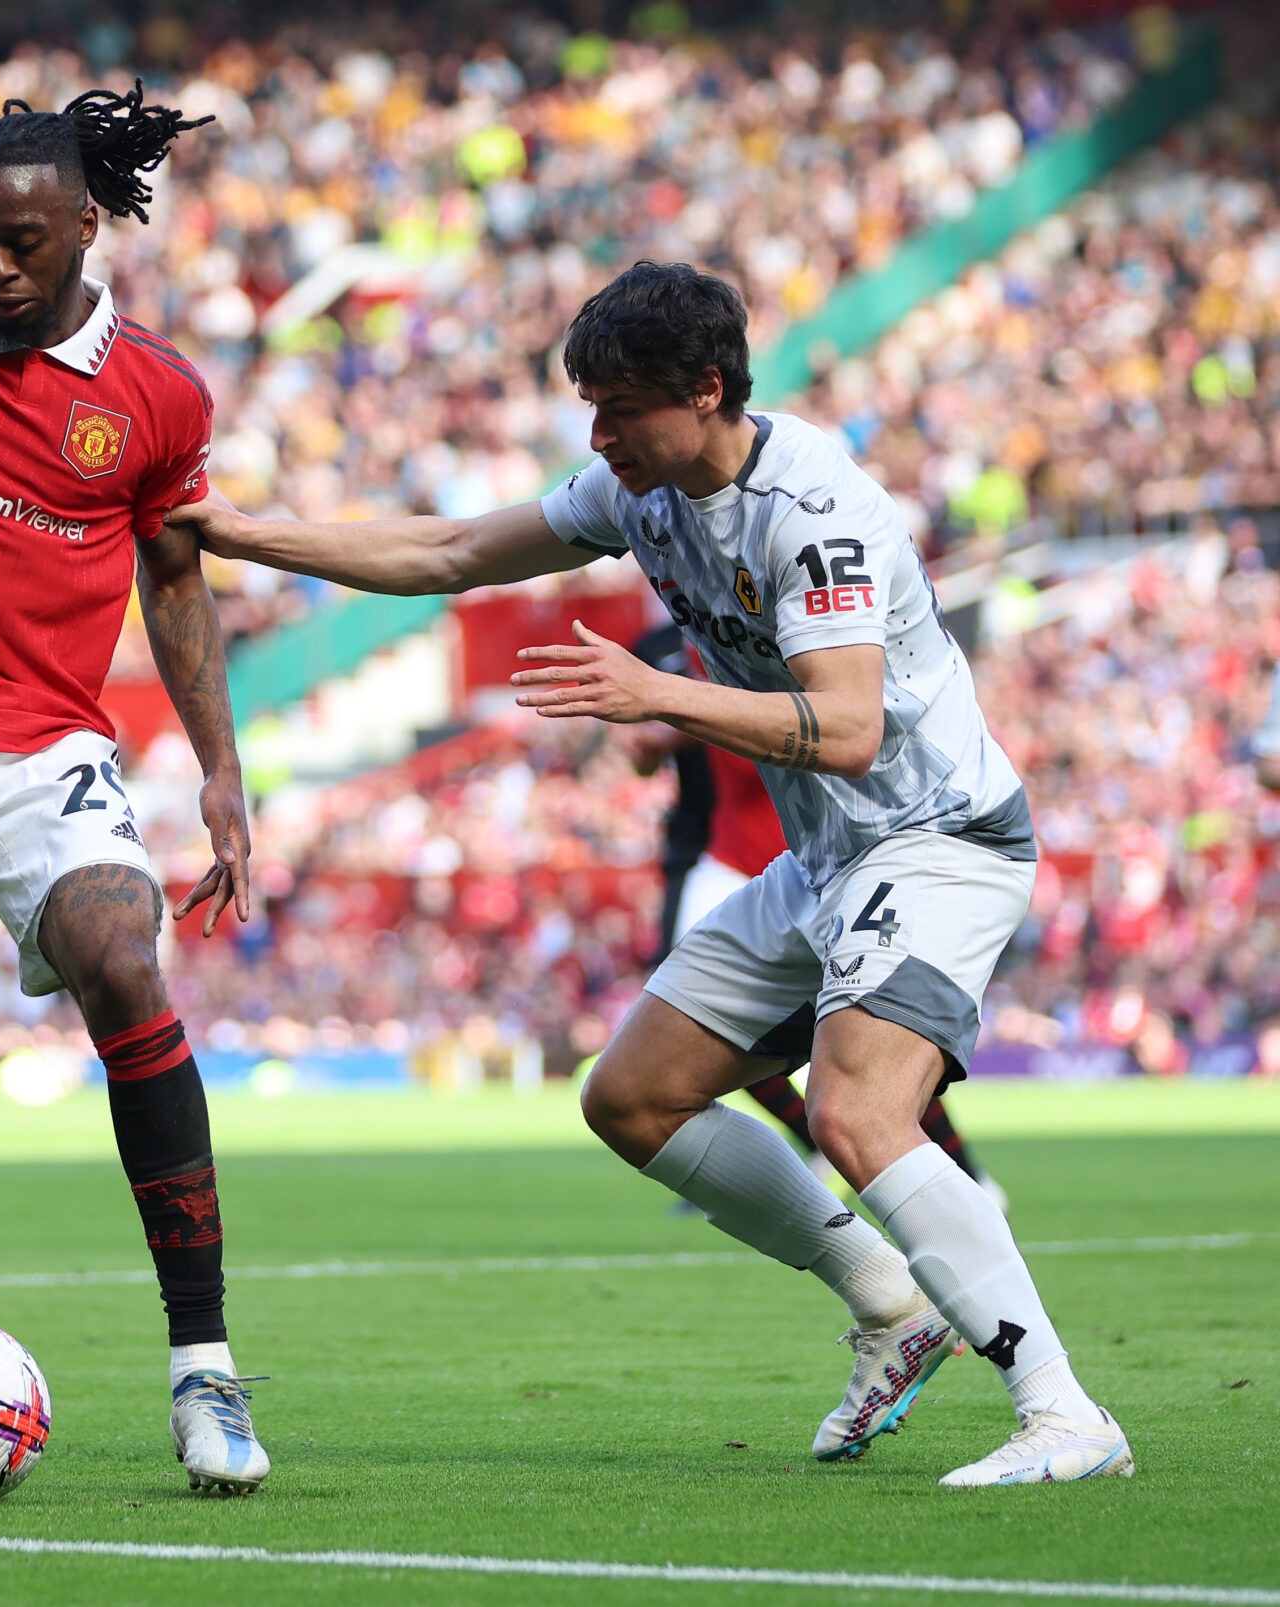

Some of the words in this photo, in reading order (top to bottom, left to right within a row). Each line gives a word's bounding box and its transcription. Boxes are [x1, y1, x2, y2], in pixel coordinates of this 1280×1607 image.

[78, 418, 117, 441] MANCHESTER
[78, 452, 105, 465] UNITED
[795, 538, 872, 589] 12
[805, 586, 875, 616] BET
[851, 881, 901, 948] 4
